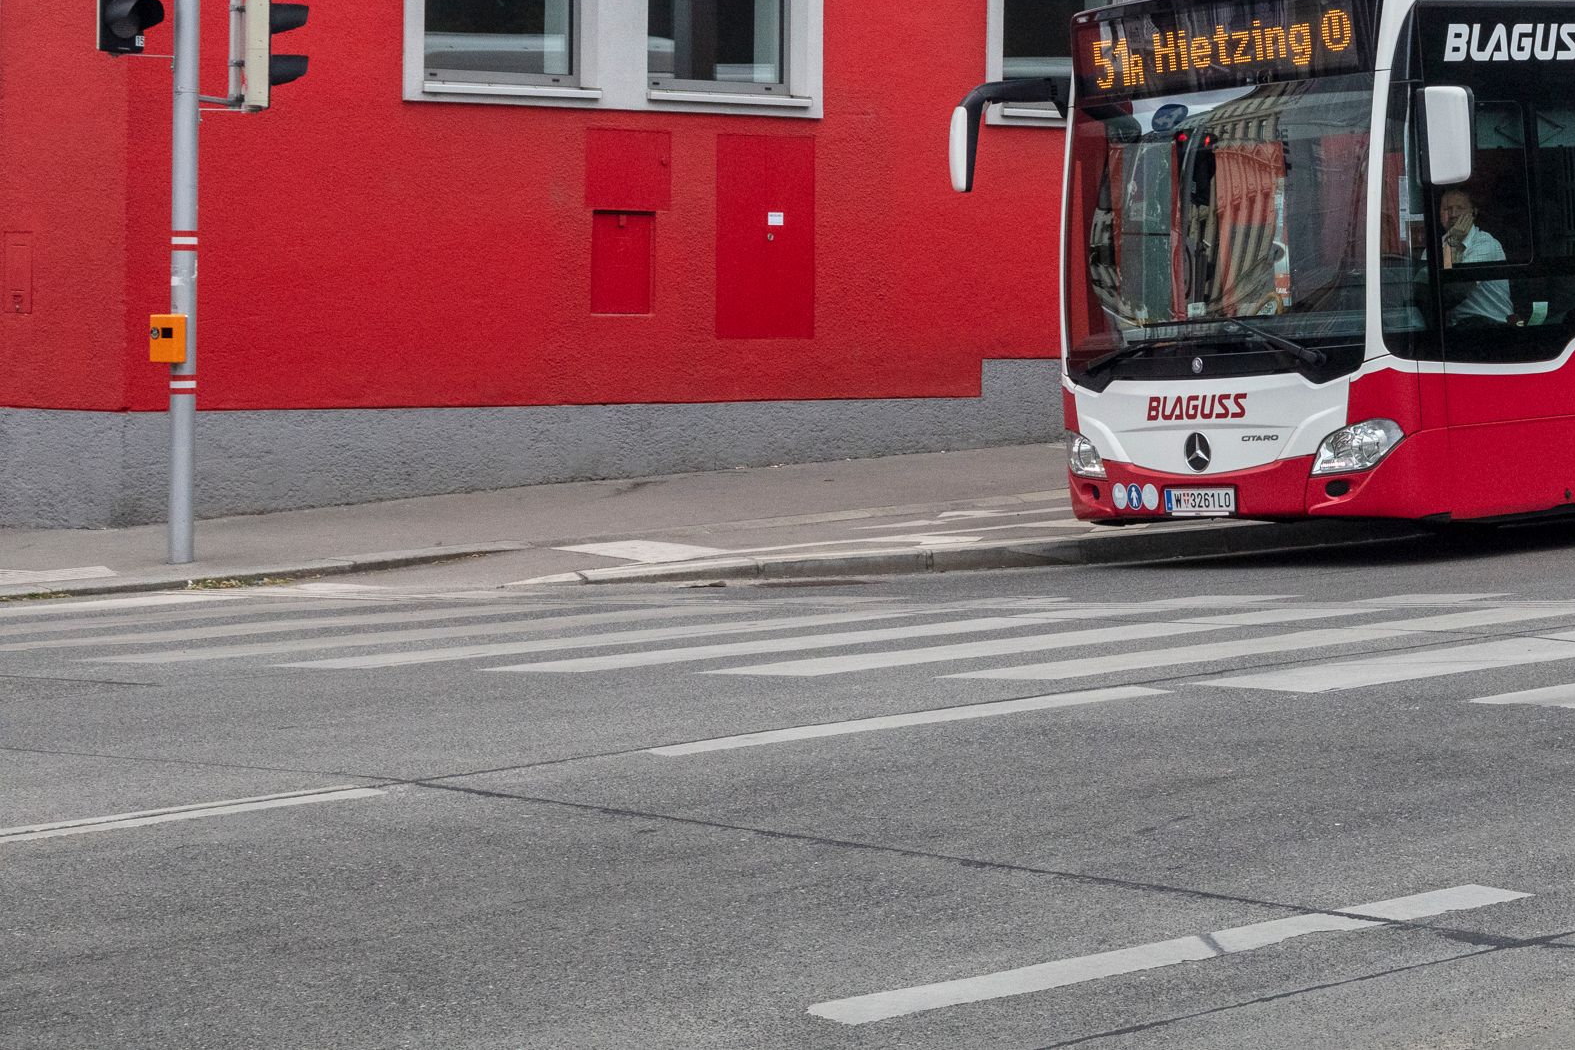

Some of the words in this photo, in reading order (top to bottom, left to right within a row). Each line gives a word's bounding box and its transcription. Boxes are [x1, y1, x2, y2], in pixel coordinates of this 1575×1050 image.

[1152, 19, 1312, 74] Hietzing
[1146, 392, 1248, 422] BLAGUSS
[1241, 434, 1280, 442] CITARO
[1174, 492, 1182, 509] W
